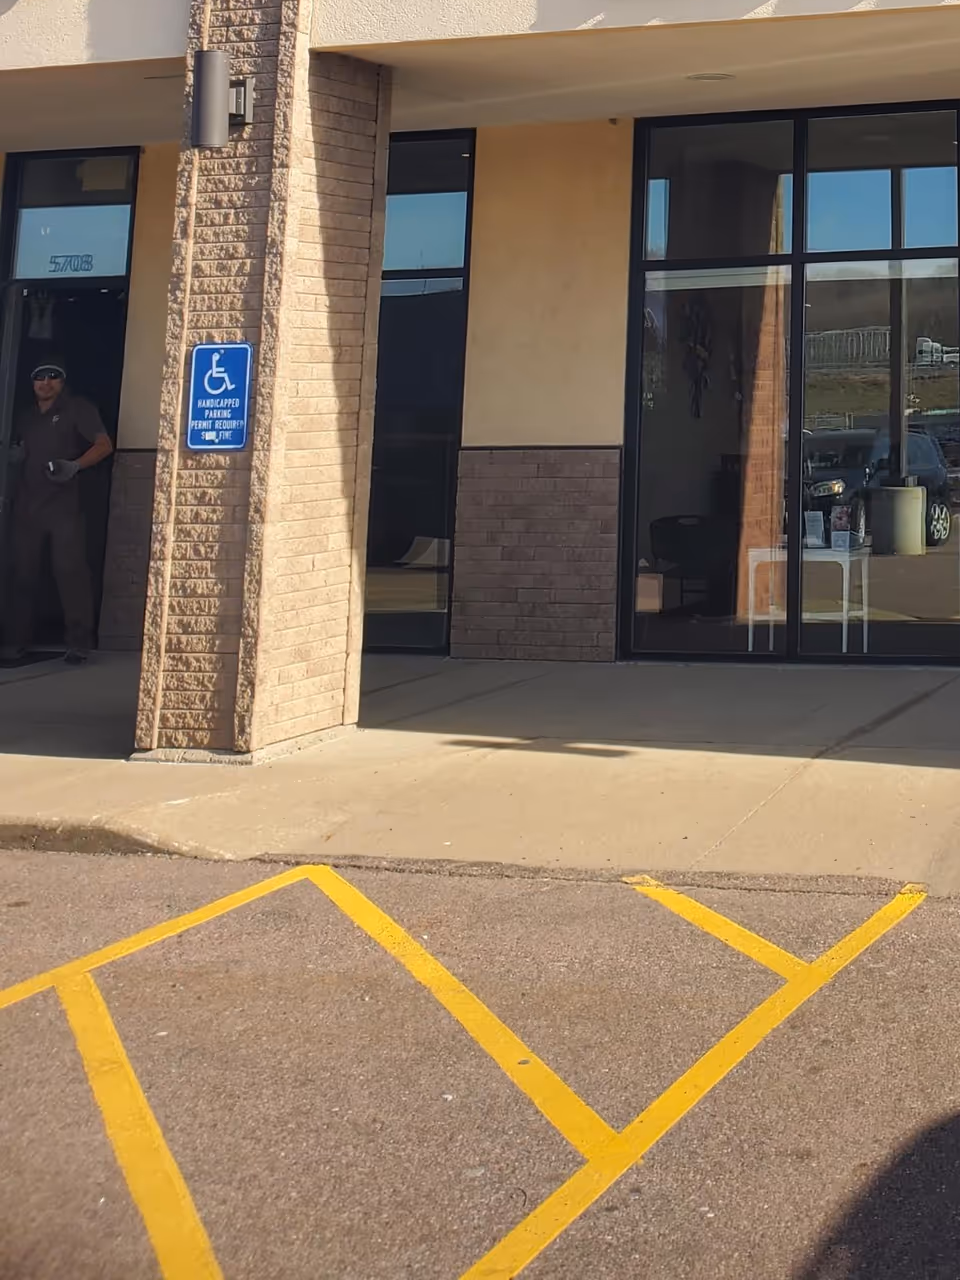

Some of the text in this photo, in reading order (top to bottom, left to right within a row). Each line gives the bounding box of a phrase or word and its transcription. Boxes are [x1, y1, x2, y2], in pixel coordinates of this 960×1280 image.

[49, 254, 93, 273] 5708
[197, 399, 240, 409] HANDICAPPED
[204, 409, 232, 419] PARKING
[191, 420, 245, 430] PERMIT REQUIRED
